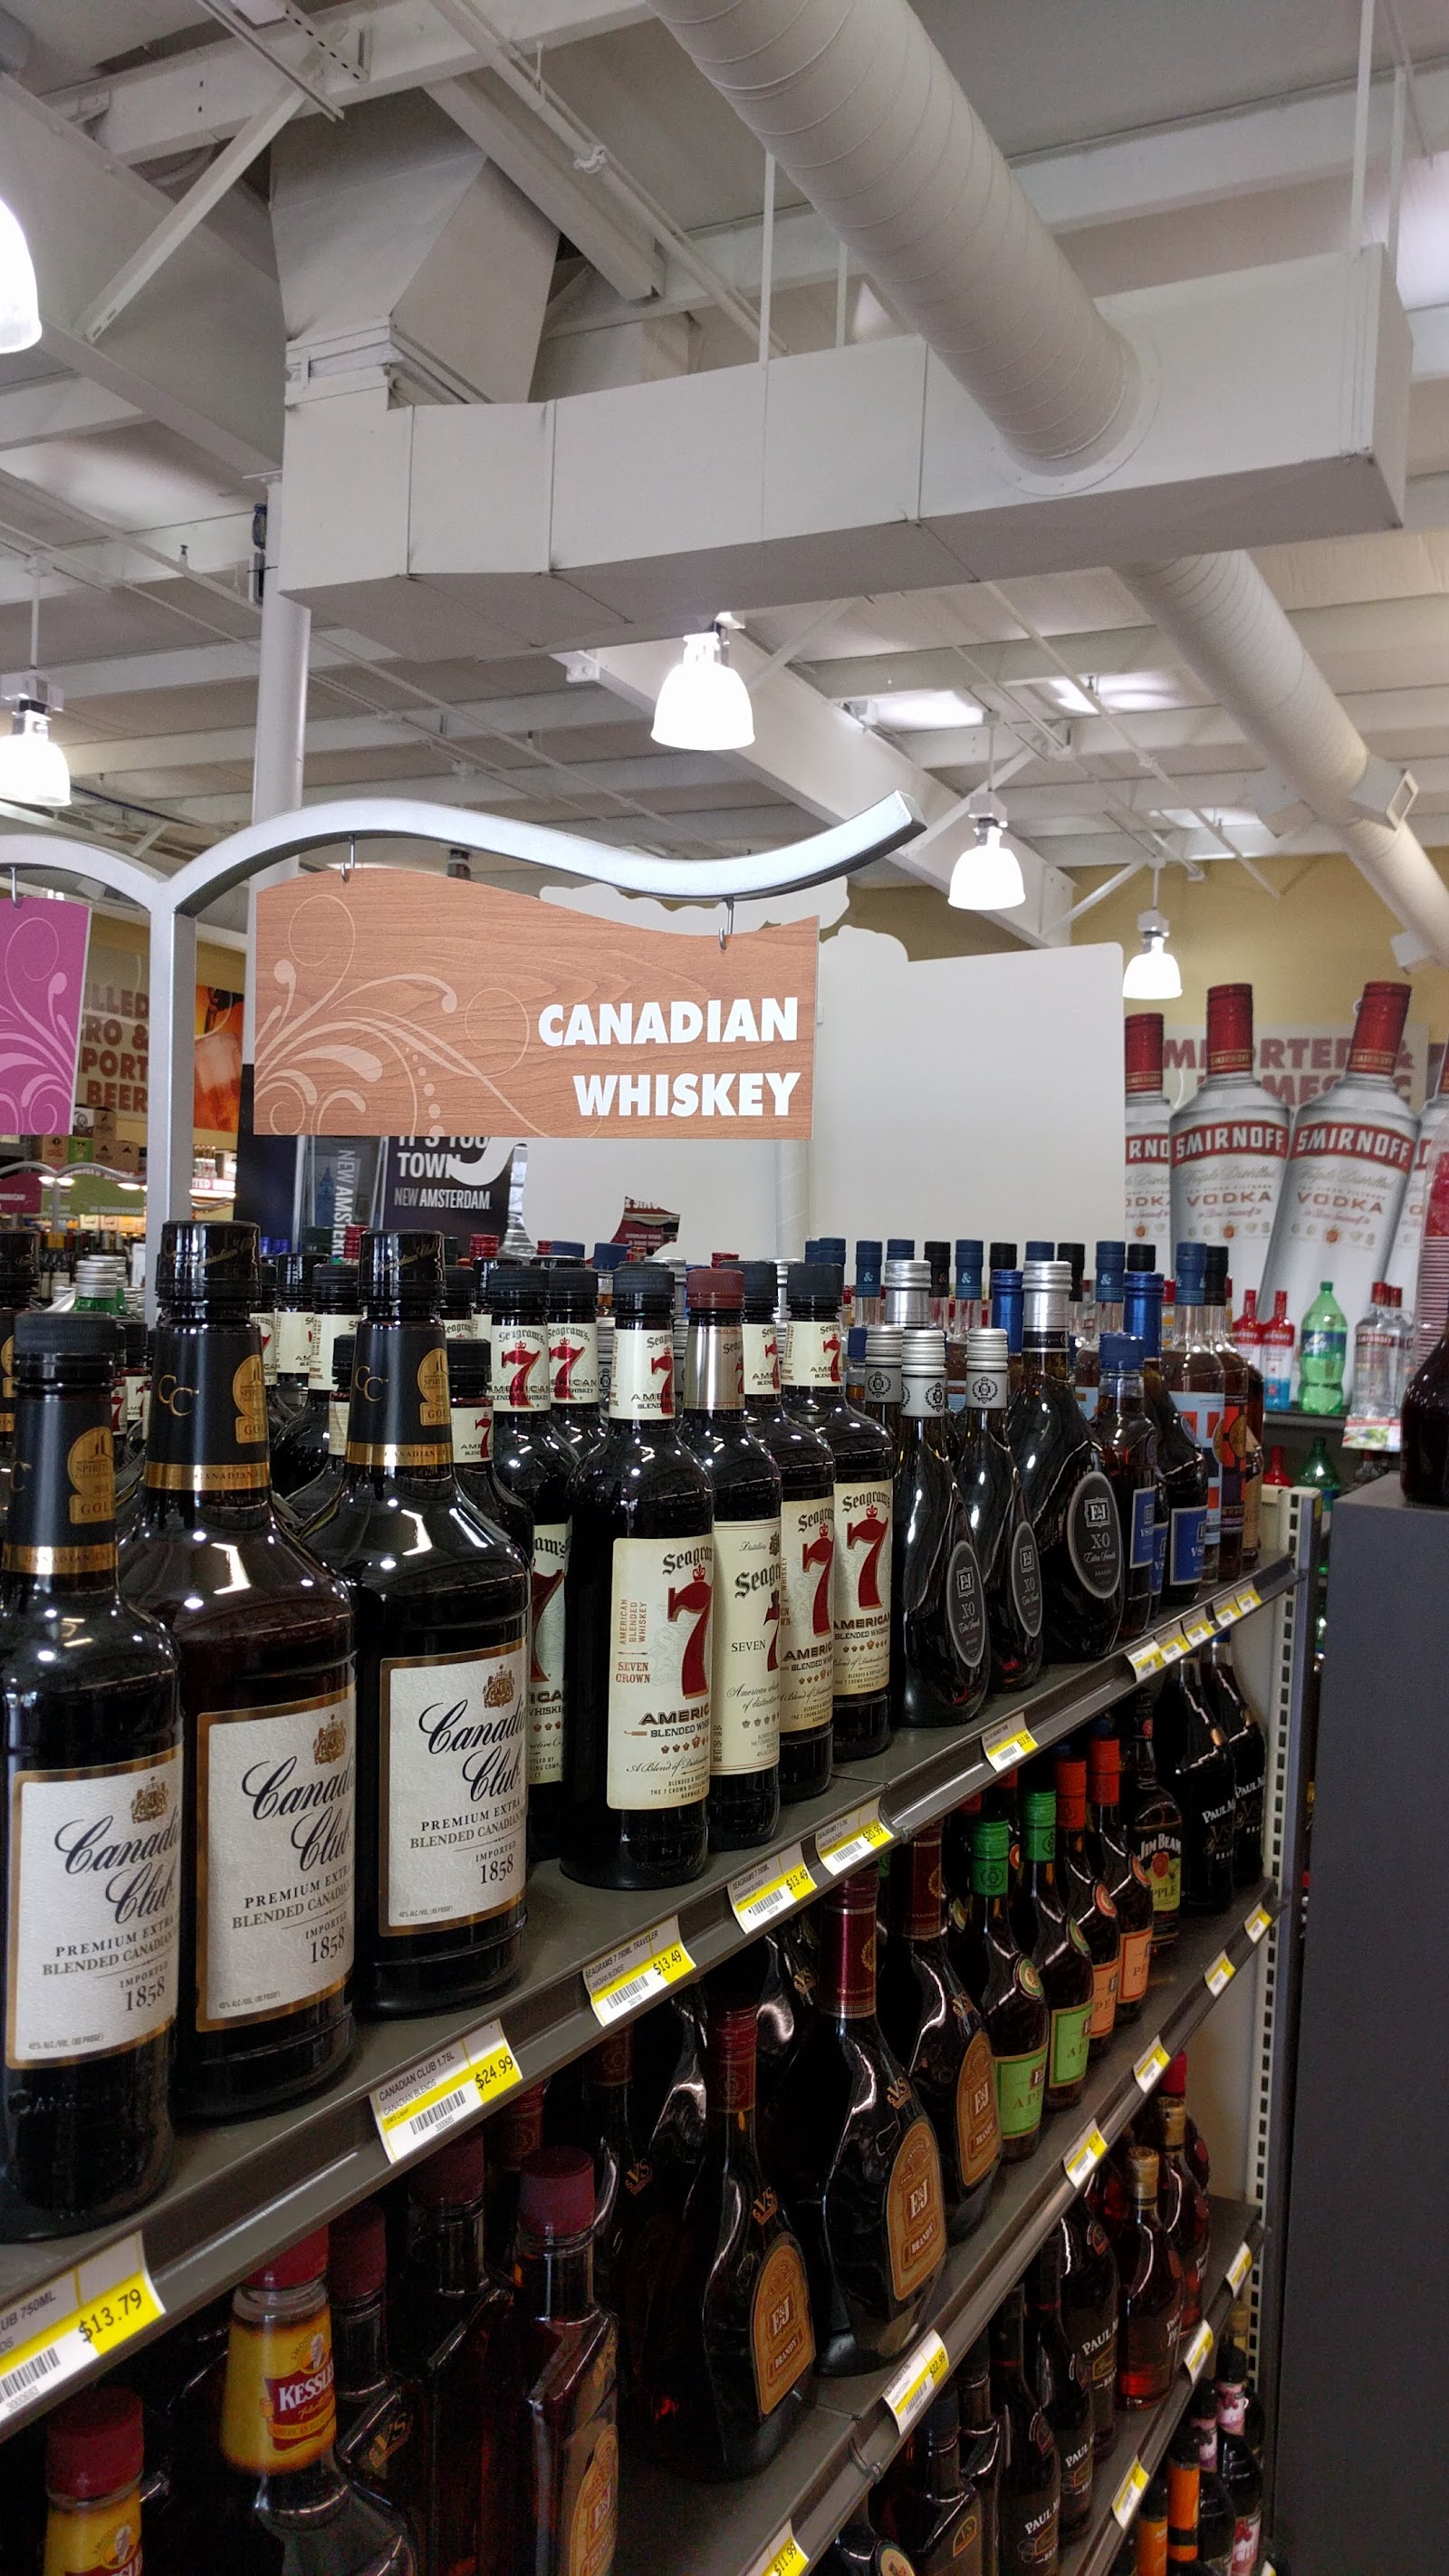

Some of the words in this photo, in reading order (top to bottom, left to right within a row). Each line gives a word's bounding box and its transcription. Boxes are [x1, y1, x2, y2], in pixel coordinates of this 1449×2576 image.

[538, 997, 798, 1046] CANADIAN
[572, 1072, 801, 1117] WHISKEY
[1176, 1126, 1284, 1159] SMIRNOFF
[1296, 1127, 1409, 1163] SMIRNOFF
[335, 1149, 356, 1185] NEW
[394, 1187, 418, 1206] NEW
[1186, 1191, 1271, 1208] VODKA
[1297, 1192, 1383, 1216] VODKA
[823, 1339, 841, 1381] 7
[502, 1350, 542, 1408] 7
[650, 1357, 675, 1414] 7
[475, 1418, 493, 1457] 7
[842, 1488, 890, 1513] Seagram's
[1089, 1504, 1106, 1521] E&J
[847, 1516, 888, 1611] 7
[802, 1537, 833, 1637] 7
[629, 1601, 638, 1643] BLENDED
[638, 1601, 647, 1643] WHISKEY
[834, 1630, 869, 1640] BLENDED
[667, 1581, 712, 1700] 7
[731, 1639, 766, 1652] SEVEN
[616, 1674, 650, 1684] CROWN
[618, 1661, 648, 1672] SEVEN
[792, 1658, 822, 1671] BLENDED
[726, 1683, 767, 1697] American
[650, 1725, 696, 1738] BLENDED
[462, 1744, 522, 1802] Club
[643, 1760, 672, 1773] Blend
[672, 1756, 683, 1777] of
[668, 1777, 690, 1787] BLENDED
[668, 1785, 687, 1794] CROWN
[1235, 1781, 1257, 1799] PAUL
[421, 1810, 490, 1831] PREMIUM
[494, 1799, 521, 1820] EXTRA
[1201, 1807, 1225, 1824] PAUL
[291, 1804, 351, 1872] Club
[410, 1830, 475, 1850] BLENDED
[477, 1812, 521, 1838] CANADIAN
[862, 1824, 884, 1842] $20.99
[475, 1840, 517, 1862] IMPORTED
[1140, 1838, 1158, 1861] JIM
[1158, 1833, 1181, 1852] BEAM
[480, 1853, 514, 1885] 1858
[732, 1873, 754, 1890] SEAGRAMS
[785, 1869, 809, 1891] $13.49
[105, 1858, 178, 1926] Club
[245, 1879, 321, 1909] PREMIUM
[1151, 1884, 1177, 1897] PPLE
[232, 1904, 305, 1929] BLENDED
[305, 1910, 348, 1940] IMPORTED
[55, 1929, 138, 1957] PREMIUM
[141, 1916, 174, 1938] EXTRA
[309, 1926, 345, 1965] 1858
[633, 1929, 659, 1951] TRAVELER
[43, 1954, 120, 1976] BLENDED
[122, 1931, 173, 1961] CANADIAN
[653, 1949, 682, 1976] $13.49
[120, 1961, 168, 1989] IMPORTED
[125, 1975, 166, 2013] 1858
[379, 2071, 417, 2101] CANADIAN
[417, 2062, 437, 2081] CLUB
[437, 2051, 456, 2068] 1.75L
[475, 2055, 513, 2091] $24.99
[383, 2093, 414, 2116] CANADIAN
[414, 2078, 437, 2097] BLENDS
[974, 2081, 989, 2116] E&J
[909, 2177, 928, 2220] E&J
[911, 2221, 934, 2254] BRANDY
[20, 2290, 57, 2321] 750ML
[78, 2288, 143, 2344] $13.79
[771, 2295, 791, 2337] E&J
[774, 2335, 798, 2369] BRANDY
[1081, 2329, 1110, 2356] PAUL
[929, 2350, 946, 2379] $22.99
[1065, 2443, 1088, 2468] PAUL
[1024, 2510, 1051, 2535] PAUL
[773, 2542, 798, 2576] $11.99
